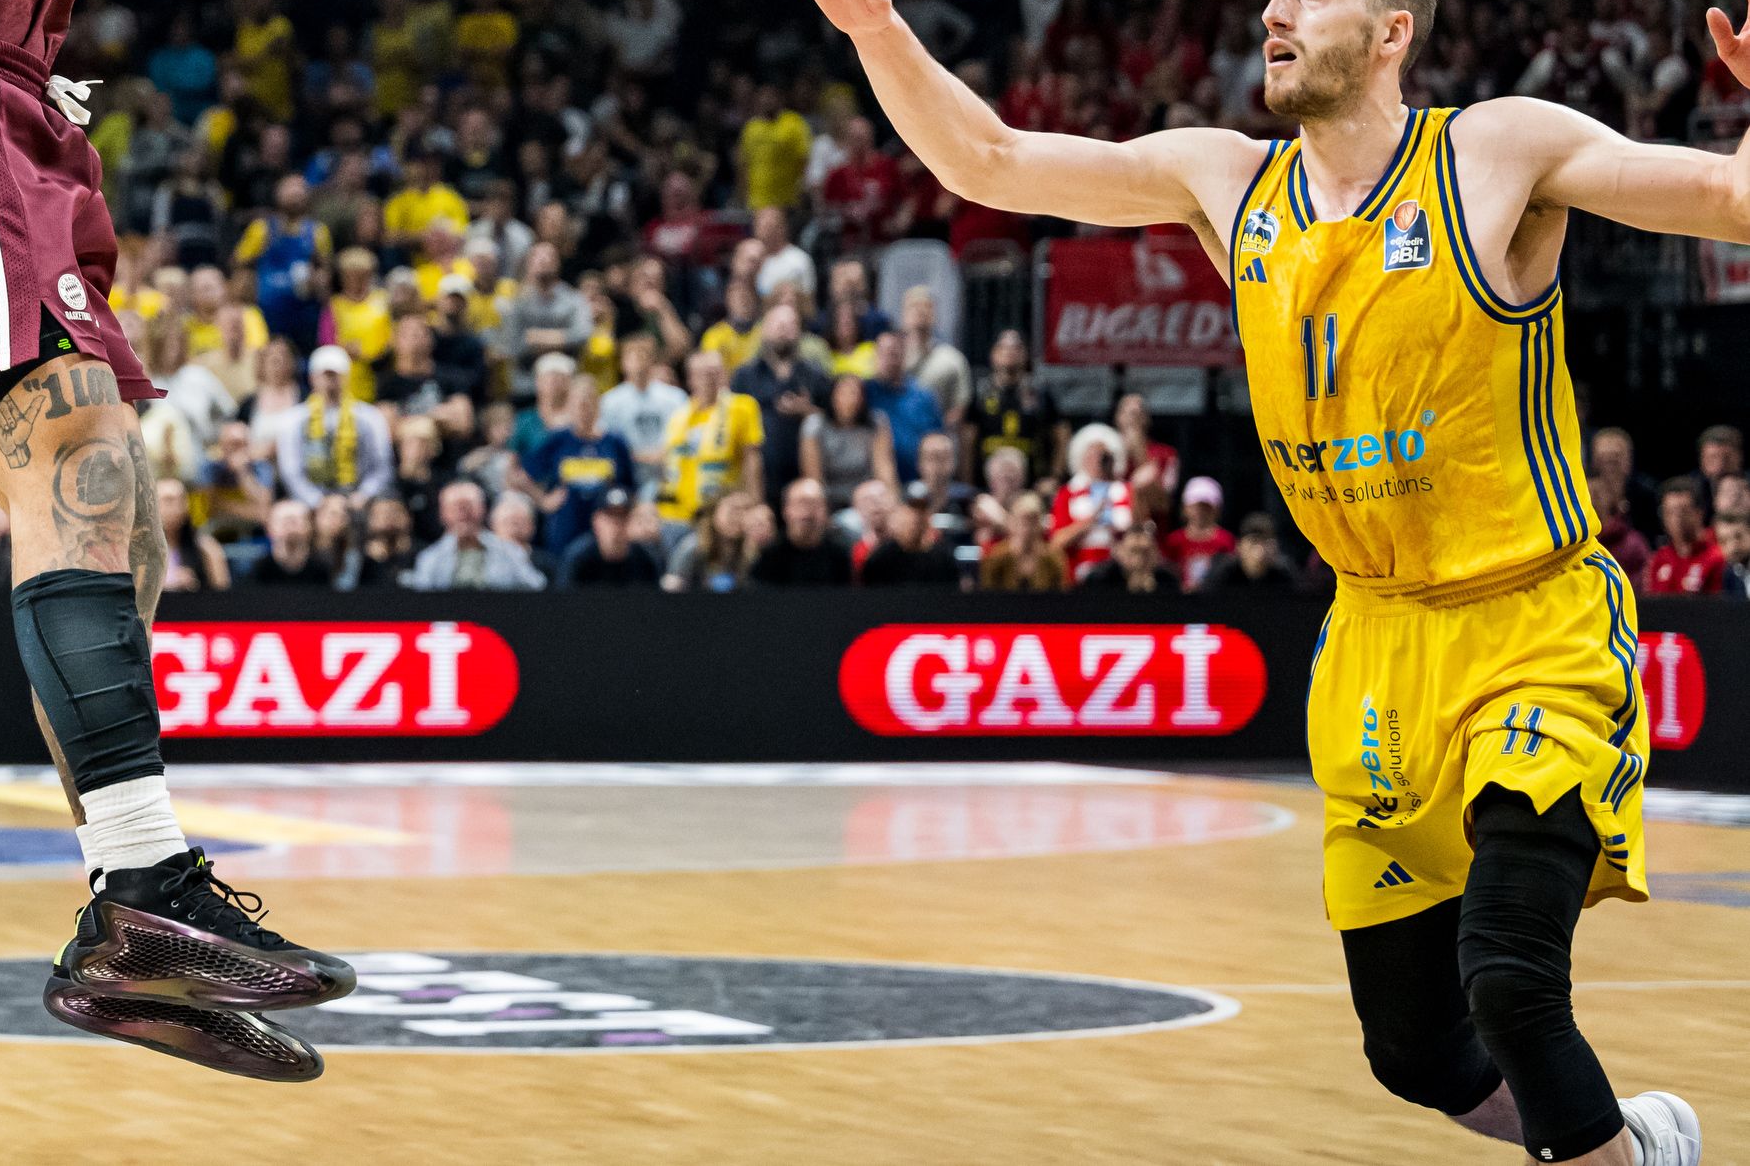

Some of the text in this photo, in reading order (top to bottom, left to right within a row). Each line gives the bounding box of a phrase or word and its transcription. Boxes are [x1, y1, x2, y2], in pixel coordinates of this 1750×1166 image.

[1387, 246, 1425, 266] BBL
[1300, 312, 1339, 401] 11
[1342, 476, 1434, 504] solutions
[1386, 709, 1411, 787] solutions
[1499, 701, 1547, 757] 11
